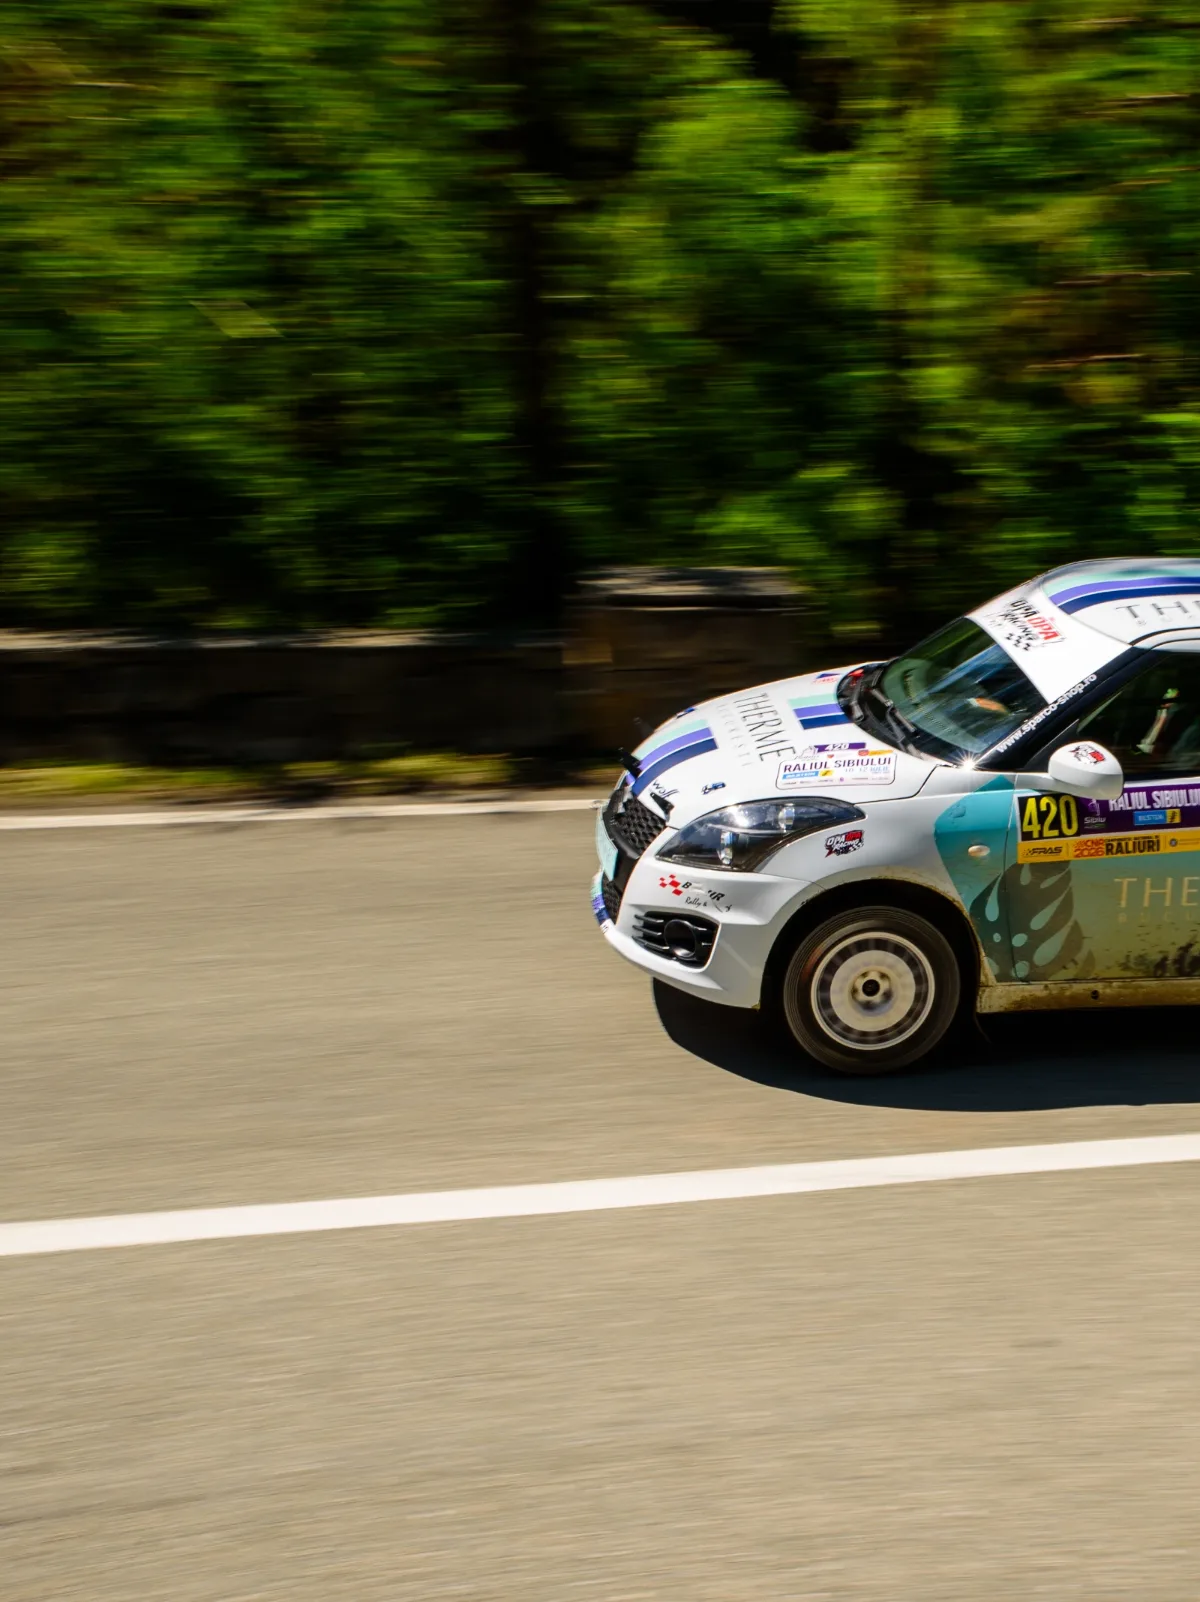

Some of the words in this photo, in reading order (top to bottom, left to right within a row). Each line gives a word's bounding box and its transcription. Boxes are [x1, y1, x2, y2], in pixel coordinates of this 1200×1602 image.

[1026, 617, 1060, 641] OPA
[996, 674, 1097, 753] www.sparco-shop.ro
[734, 692, 796, 762] THERME
[825, 743, 849, 752] 420
[783, 761, 829, 773] RALIUL
[833, 757, 891, 768] SIBIULUI
[1109, 790, 1151, 812] RALIUL
[1022, 795, 1079, 839] 420
[1029, 846, 1063, 856] FRAS
[1073, 847, 1105, 858] 2026
[1105, 839, 1160, 855] RALIURI
